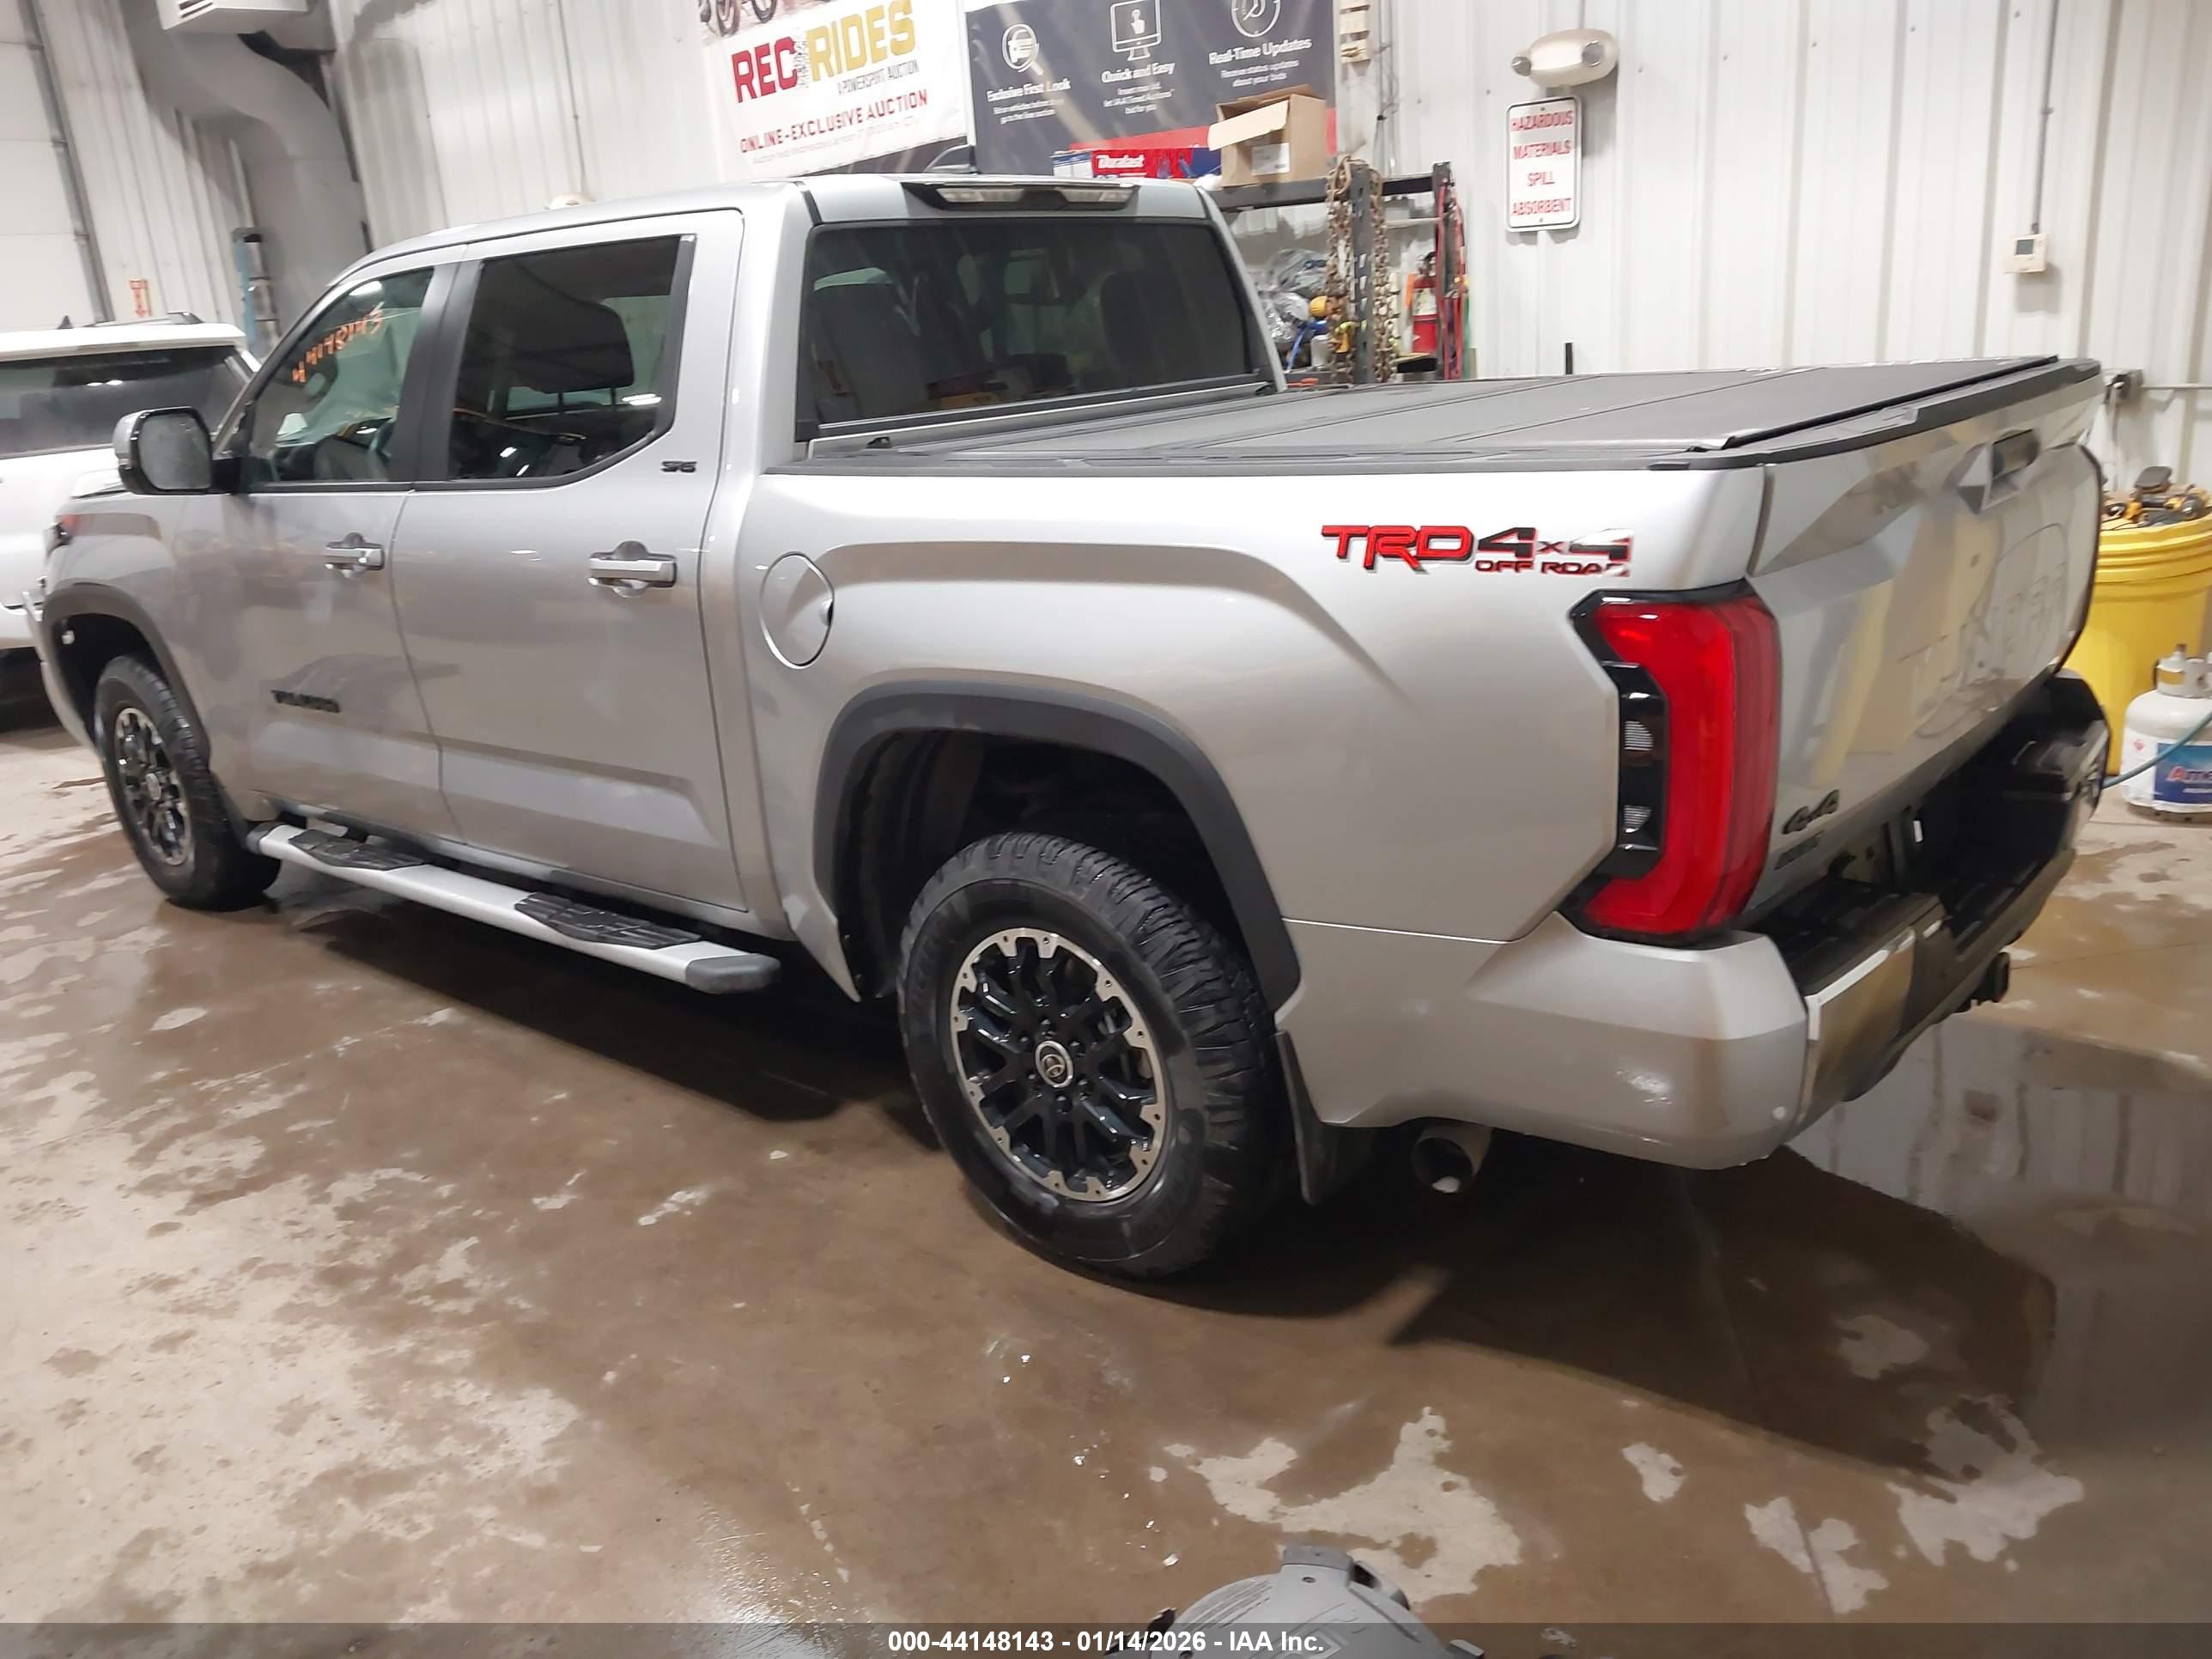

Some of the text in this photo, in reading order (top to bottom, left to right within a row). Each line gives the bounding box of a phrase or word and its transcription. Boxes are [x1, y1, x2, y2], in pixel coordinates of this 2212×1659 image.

[732, 36, 798, 103] REC
[805, 0, 915, 82] RIDES
[1262, 39, 1312, 57] Updates
[1102, 69, 1132, 82] Quick
[1152, 63, 1175, 75] Easy
[741, 107, 862, 153] ONLINE-EXCLUSIVE
[867, 89, 928, 120] AUCTION
[1511, 110, 1575, 131] HAZARDOUS
[1513, 140, 1572, 159] MATERIALS
[1527, 172, 1554, 186] SPILL
[1511, 198, 1571, 216] ABSORBENT
[1322, 526, 1474, 572] TRD
[1475, 560, 1533, 573] OFF
